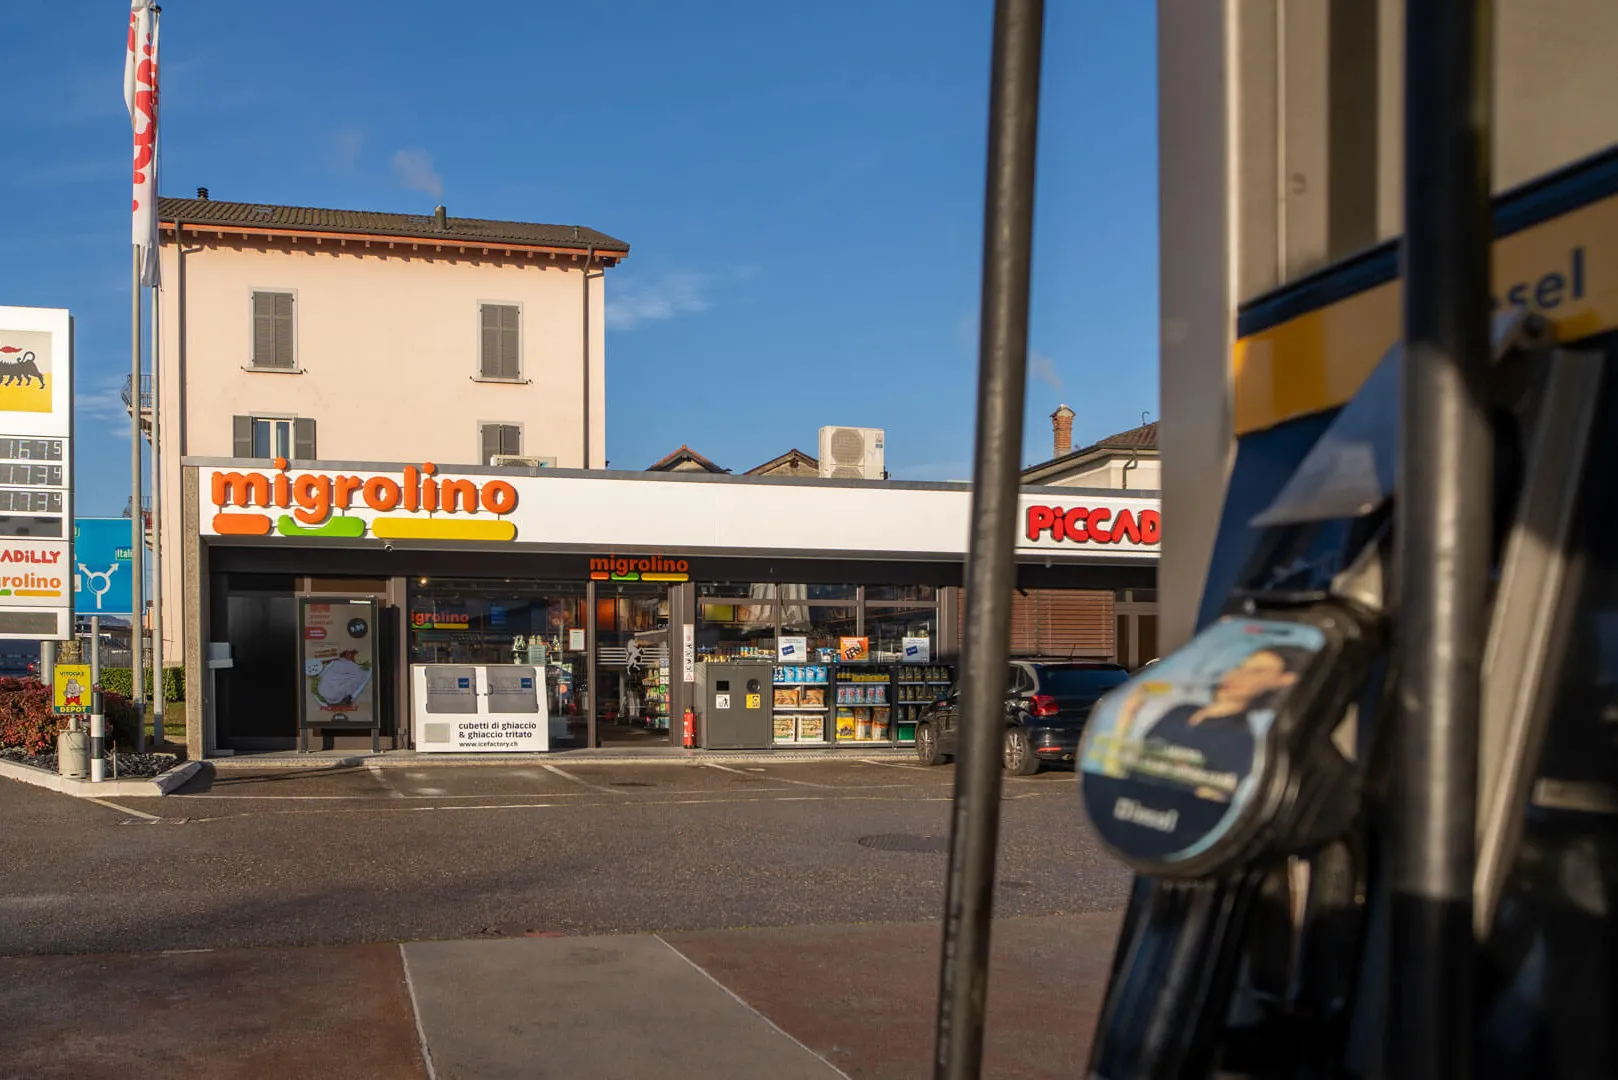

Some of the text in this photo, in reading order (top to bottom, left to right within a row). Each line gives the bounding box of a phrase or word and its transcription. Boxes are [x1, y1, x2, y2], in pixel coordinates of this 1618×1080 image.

[211, 456, 516, 524] migrolino
[590, 554, 689, 576] migrolino
[0, 572, 62, 589] rolino
[459, 722, 537, 732] cubetti di ghiaccio
[459, 730, 532, 740] & ghiaccio tritato
